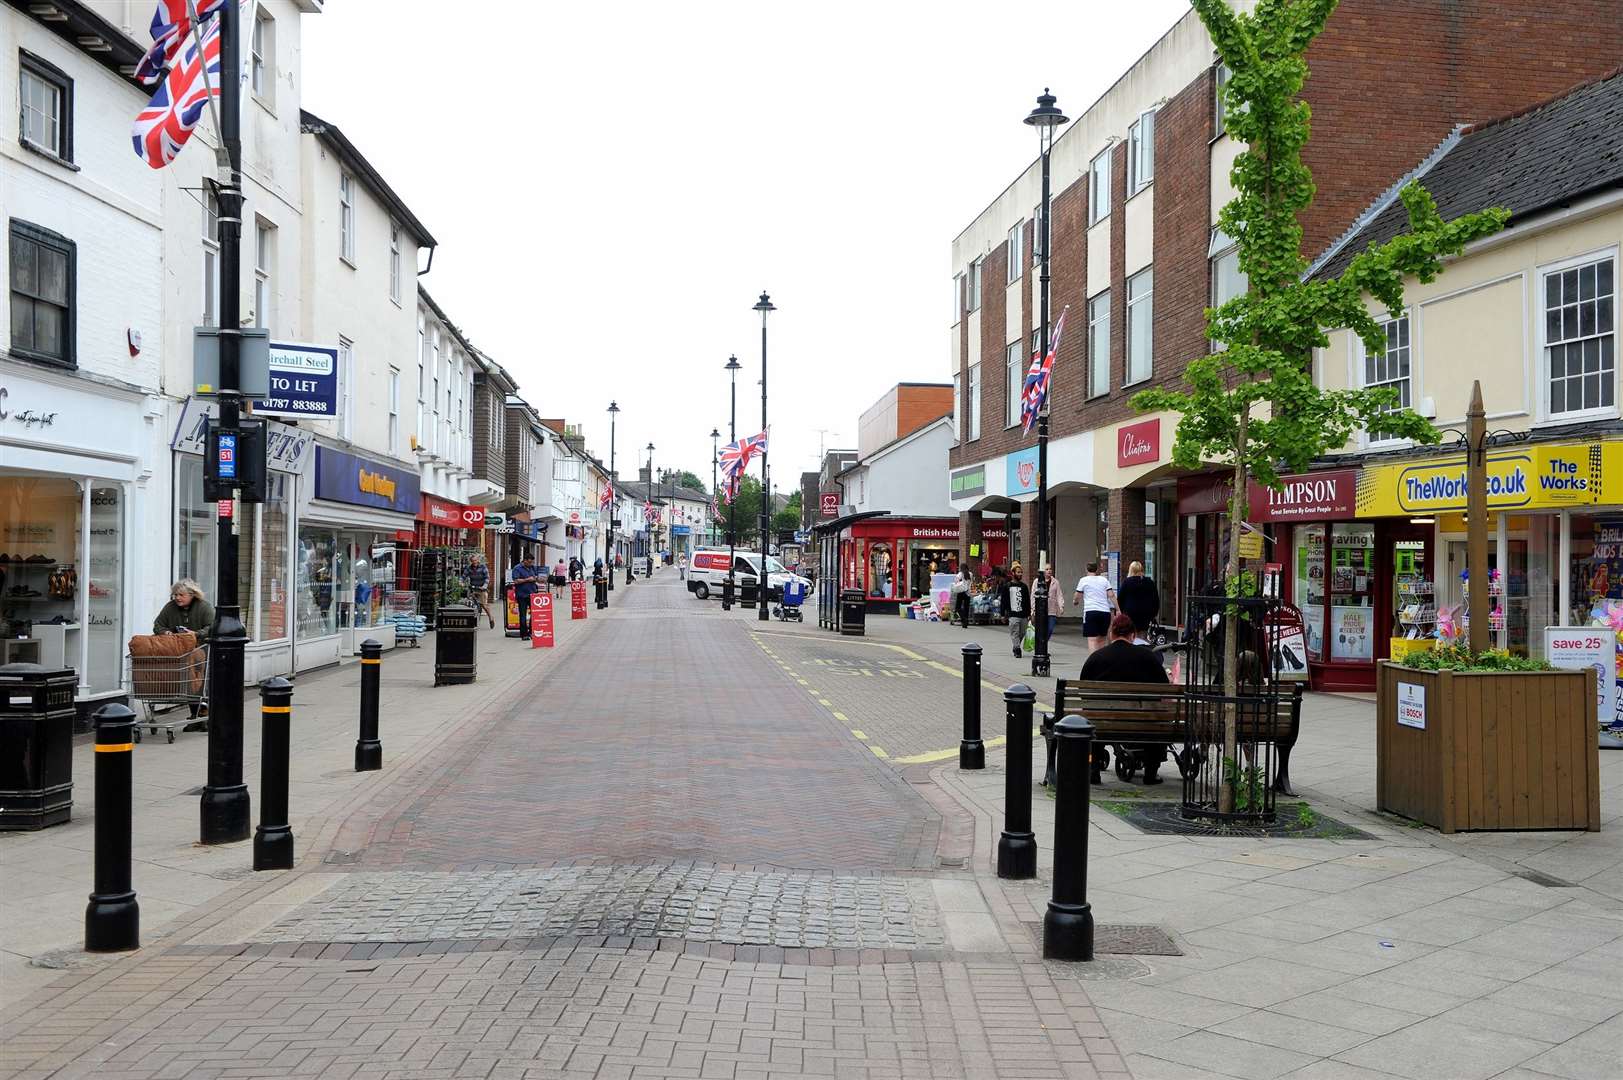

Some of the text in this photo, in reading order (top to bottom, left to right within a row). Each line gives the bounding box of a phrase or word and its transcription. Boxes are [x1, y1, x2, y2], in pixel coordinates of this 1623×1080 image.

[270, 353, 329, 368] irchall Steel
[271, 377, 318, 392] TO LET
[262, 398, 327, 412] 01787 883888
[1122, 432, 1152, 459] Clintons
[221, 451, 232, 460] 51
[1549, 459, 1578, 474] The
[1406, 466, 1526, 500] TheWorko.uk
[1540, 475, 1588, 490] Works
[1266, 479, 1337, 505] TIMPSON
[462, 510, 483, 524] QD
[1283, 507, 1298, 515] Service
[1316, 505, 1332, 514] People
[913, 528, 940, 538] British
[941, 528, 960, 538] Hear
[1308, 533, 1368, 548] Enraving
[1593, 543, 1616, 559] KIDS
[533, 595, 550, 608] QD
[1552, 639, 1583, 649] save
[1406, 707, 1423, 720] BOSCH
